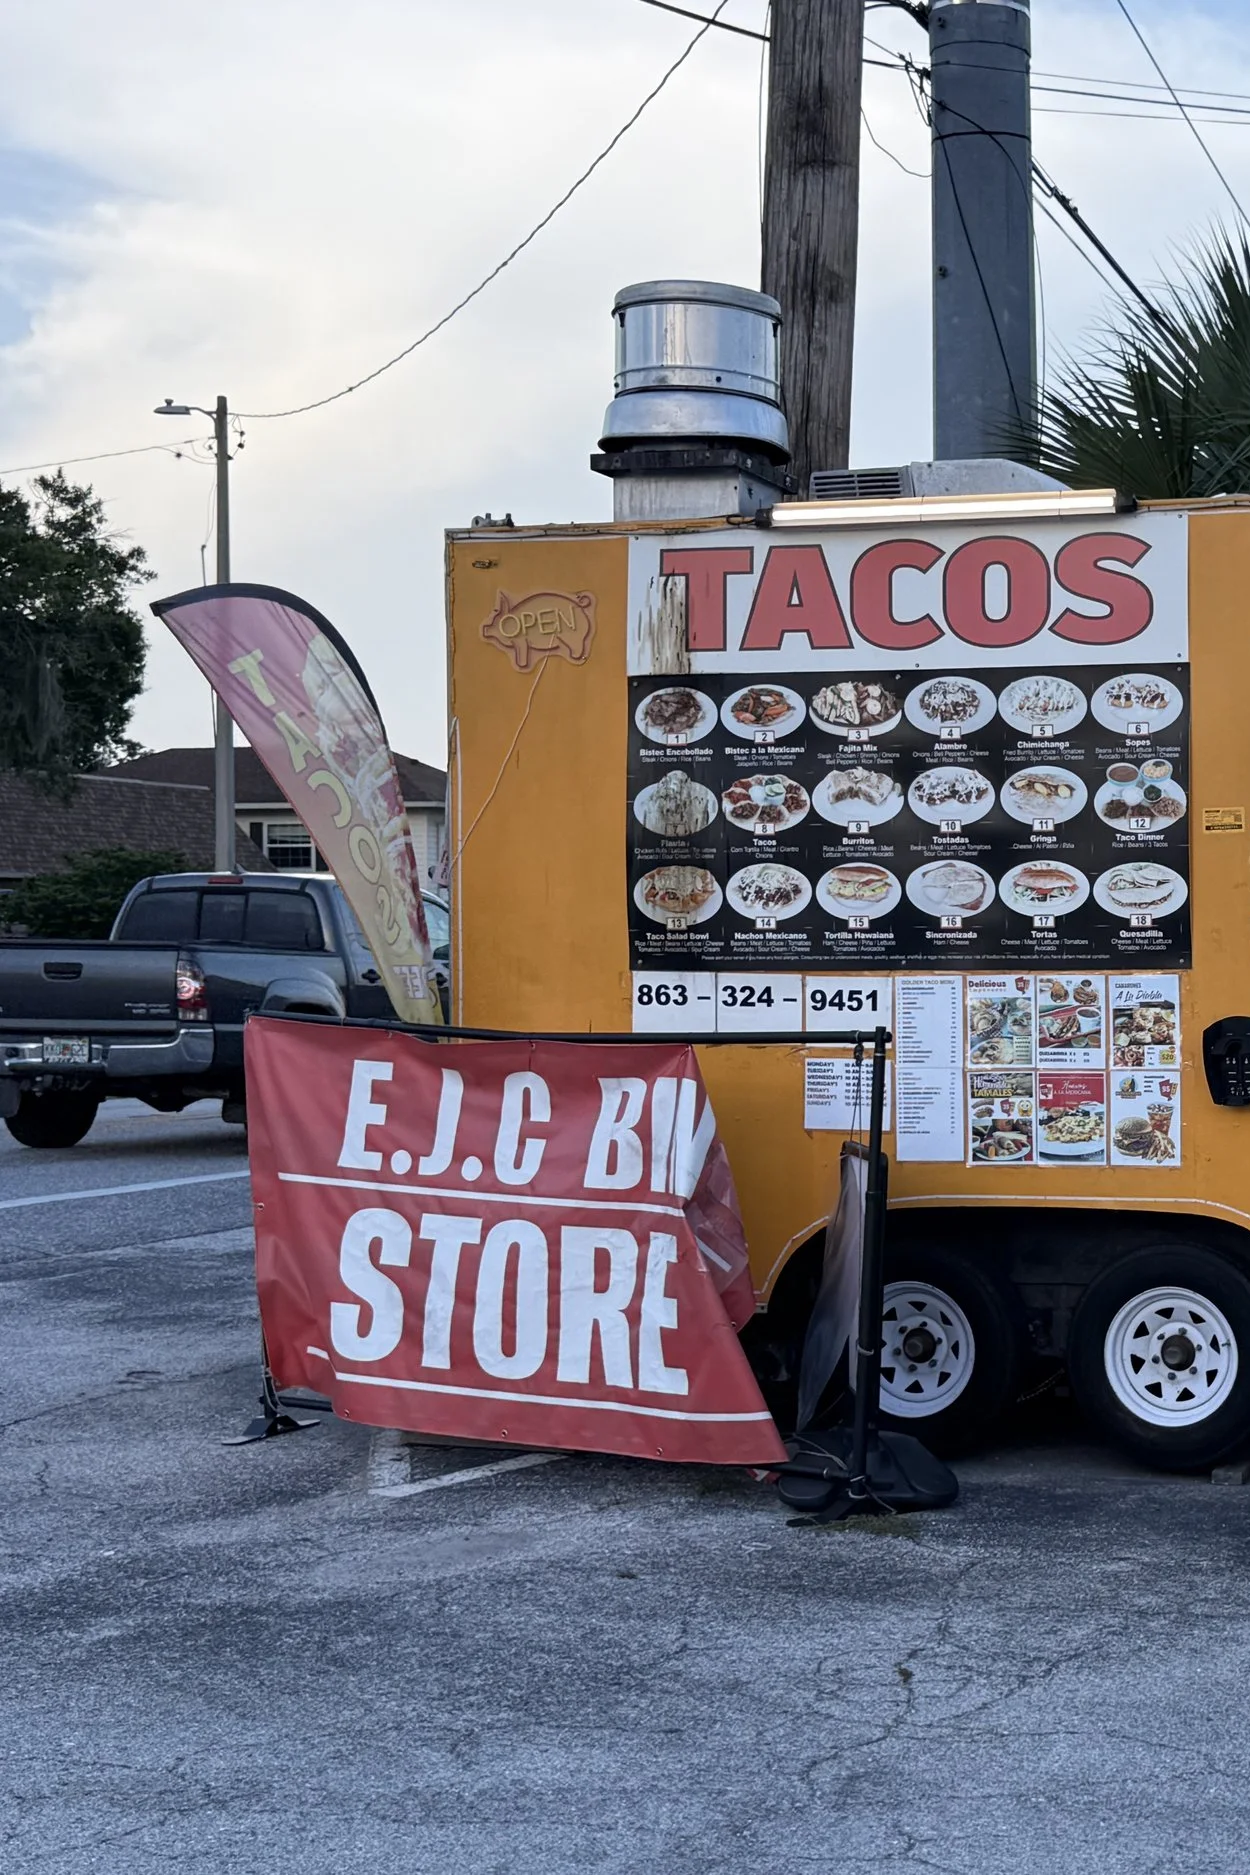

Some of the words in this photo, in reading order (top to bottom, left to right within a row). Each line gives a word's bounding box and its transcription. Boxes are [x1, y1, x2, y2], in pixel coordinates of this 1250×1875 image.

[659, 531, 1153, 653] TACOS
[499, 605, 576, 637] OPEN
[947, 729, 953, 737] 4
[1040, 727, 1045, 735] 5
[1136, 725, 1141, 733] 6
[761, 733, 767, 742] 2
[855, 731, 861, 739] 3
[1017, 741, 1069, 750] Chimichanga
[1126, 738, 1150, 747] Sopes
[839, 745, 860, 753] Fajita
[945, 822, 956, 830] 10
[1039, 821, 1048, 829] 11
[1135, 819, 1145, 827] 12
[762, 825, 767, 833] 8
[856, 823, 861, 832] 9
[932, 836, 969, 844] Tostadas
[1030, 835, 1056, 844] Gringa
[672, 919, 681, 928] 13
[761, 919, 771, 927] 14
[946, 918, 956, 926] 16
[1039, 917, 1049, 925] 17
[1135, 916, 1146, 924] 18
[1120, 930, 1162, 938] Quesadilla
[637, 984, 689, 1006] 863
[721, 985, 775, 1007] 324
[810, 989, 878, 1011] 9451
[337, 1059, 552, 1186] E.J.C
[330, 1207, 690, 1396] STORE
